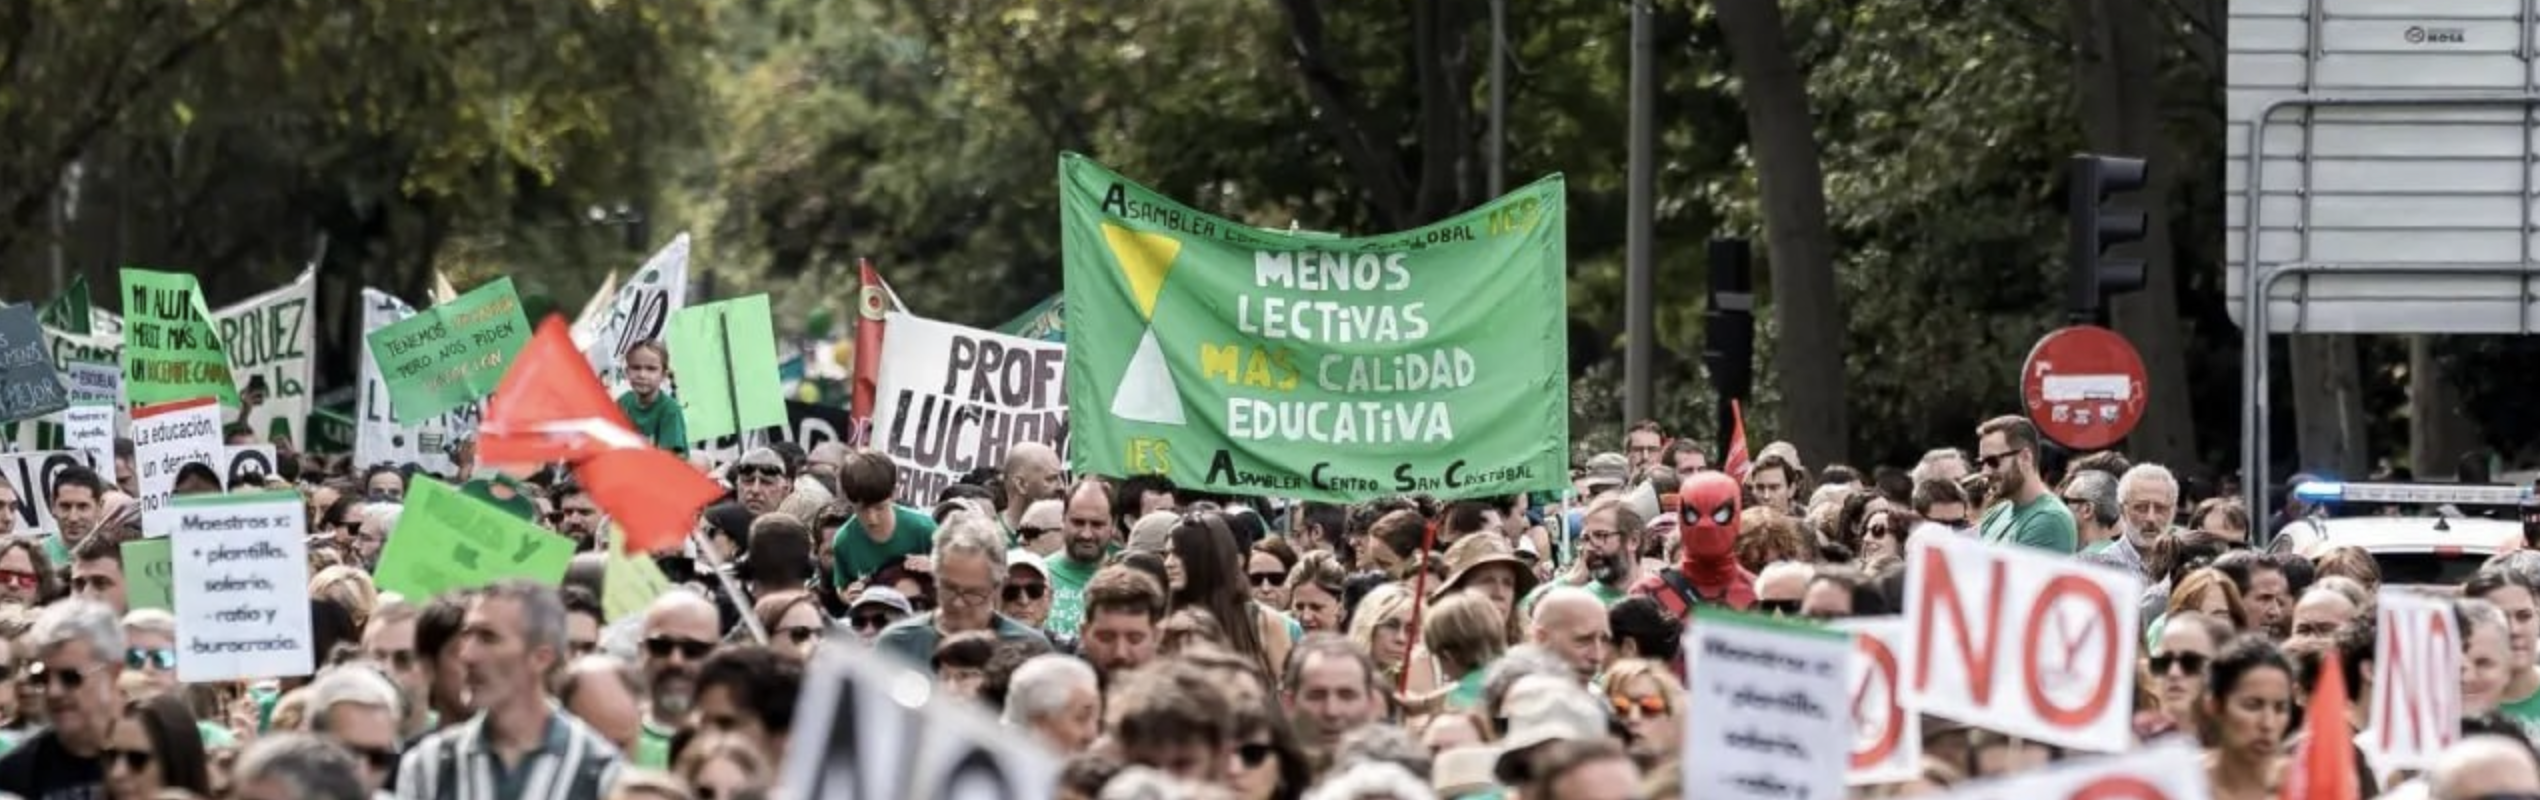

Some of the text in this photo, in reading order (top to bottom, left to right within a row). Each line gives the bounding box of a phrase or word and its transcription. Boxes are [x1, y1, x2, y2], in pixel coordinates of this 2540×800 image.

[1254, 250, 1411, 291] MENOS
[385, 322, 447, 358] TENEMOS
[944, 335, 1068, 410] PROF
[135, 424, 149, 446] La
[143, 450, 215, 478] un derho,
[1125, 437, 1172, 474] IES
[1394, 463, 1441, 492] SAN
[143, 491, 159, 513] no
[181, 515, 269, 532] Maestros
[215, 603, 260, 623] ratio
[265, 608, 277, 627] y
[1913, 545, 2120, 729] NO
[2380, 609, 2453, 755] NO
